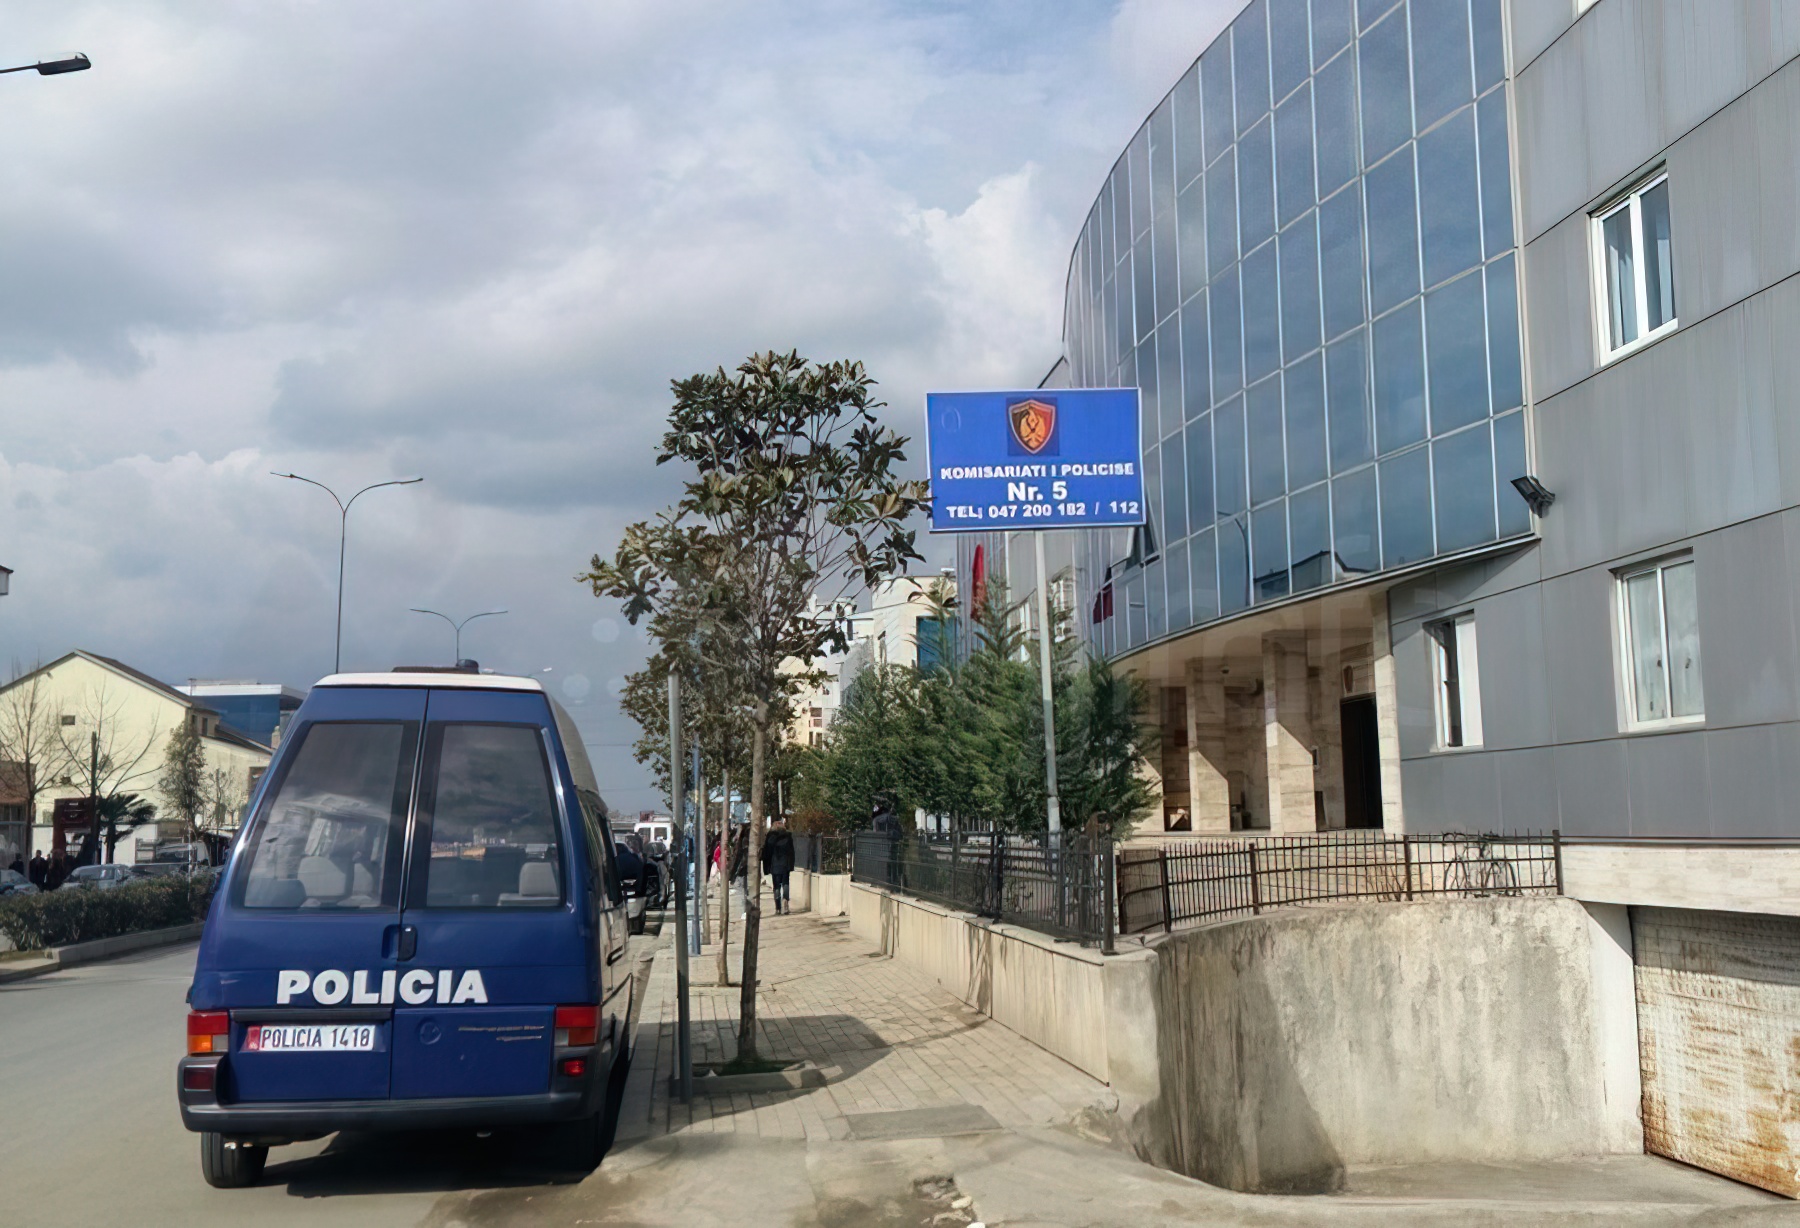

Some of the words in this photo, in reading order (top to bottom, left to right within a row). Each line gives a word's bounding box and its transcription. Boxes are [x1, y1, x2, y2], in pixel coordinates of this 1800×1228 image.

[941, 465, 1046, 479] KOMISARIATI
[1051, 465, 1057, 477] I
[1061, 463, 1134, 476] POLICISE
[1007, 482, 1043, 501] Nr.
[1052, 481, 1067, 500] 5
[988, 505, 1018, 518] 047
[1022, 504, 1052, 517] 200
[1094, 501, 1100, 515] /
[1109, 501, 1139, 514] 112
[276, 969, 488, 1005] POLICIA
[261, 1028, 322, 1048] POLICIA
[331, 1027, 371, 1048] 1418
